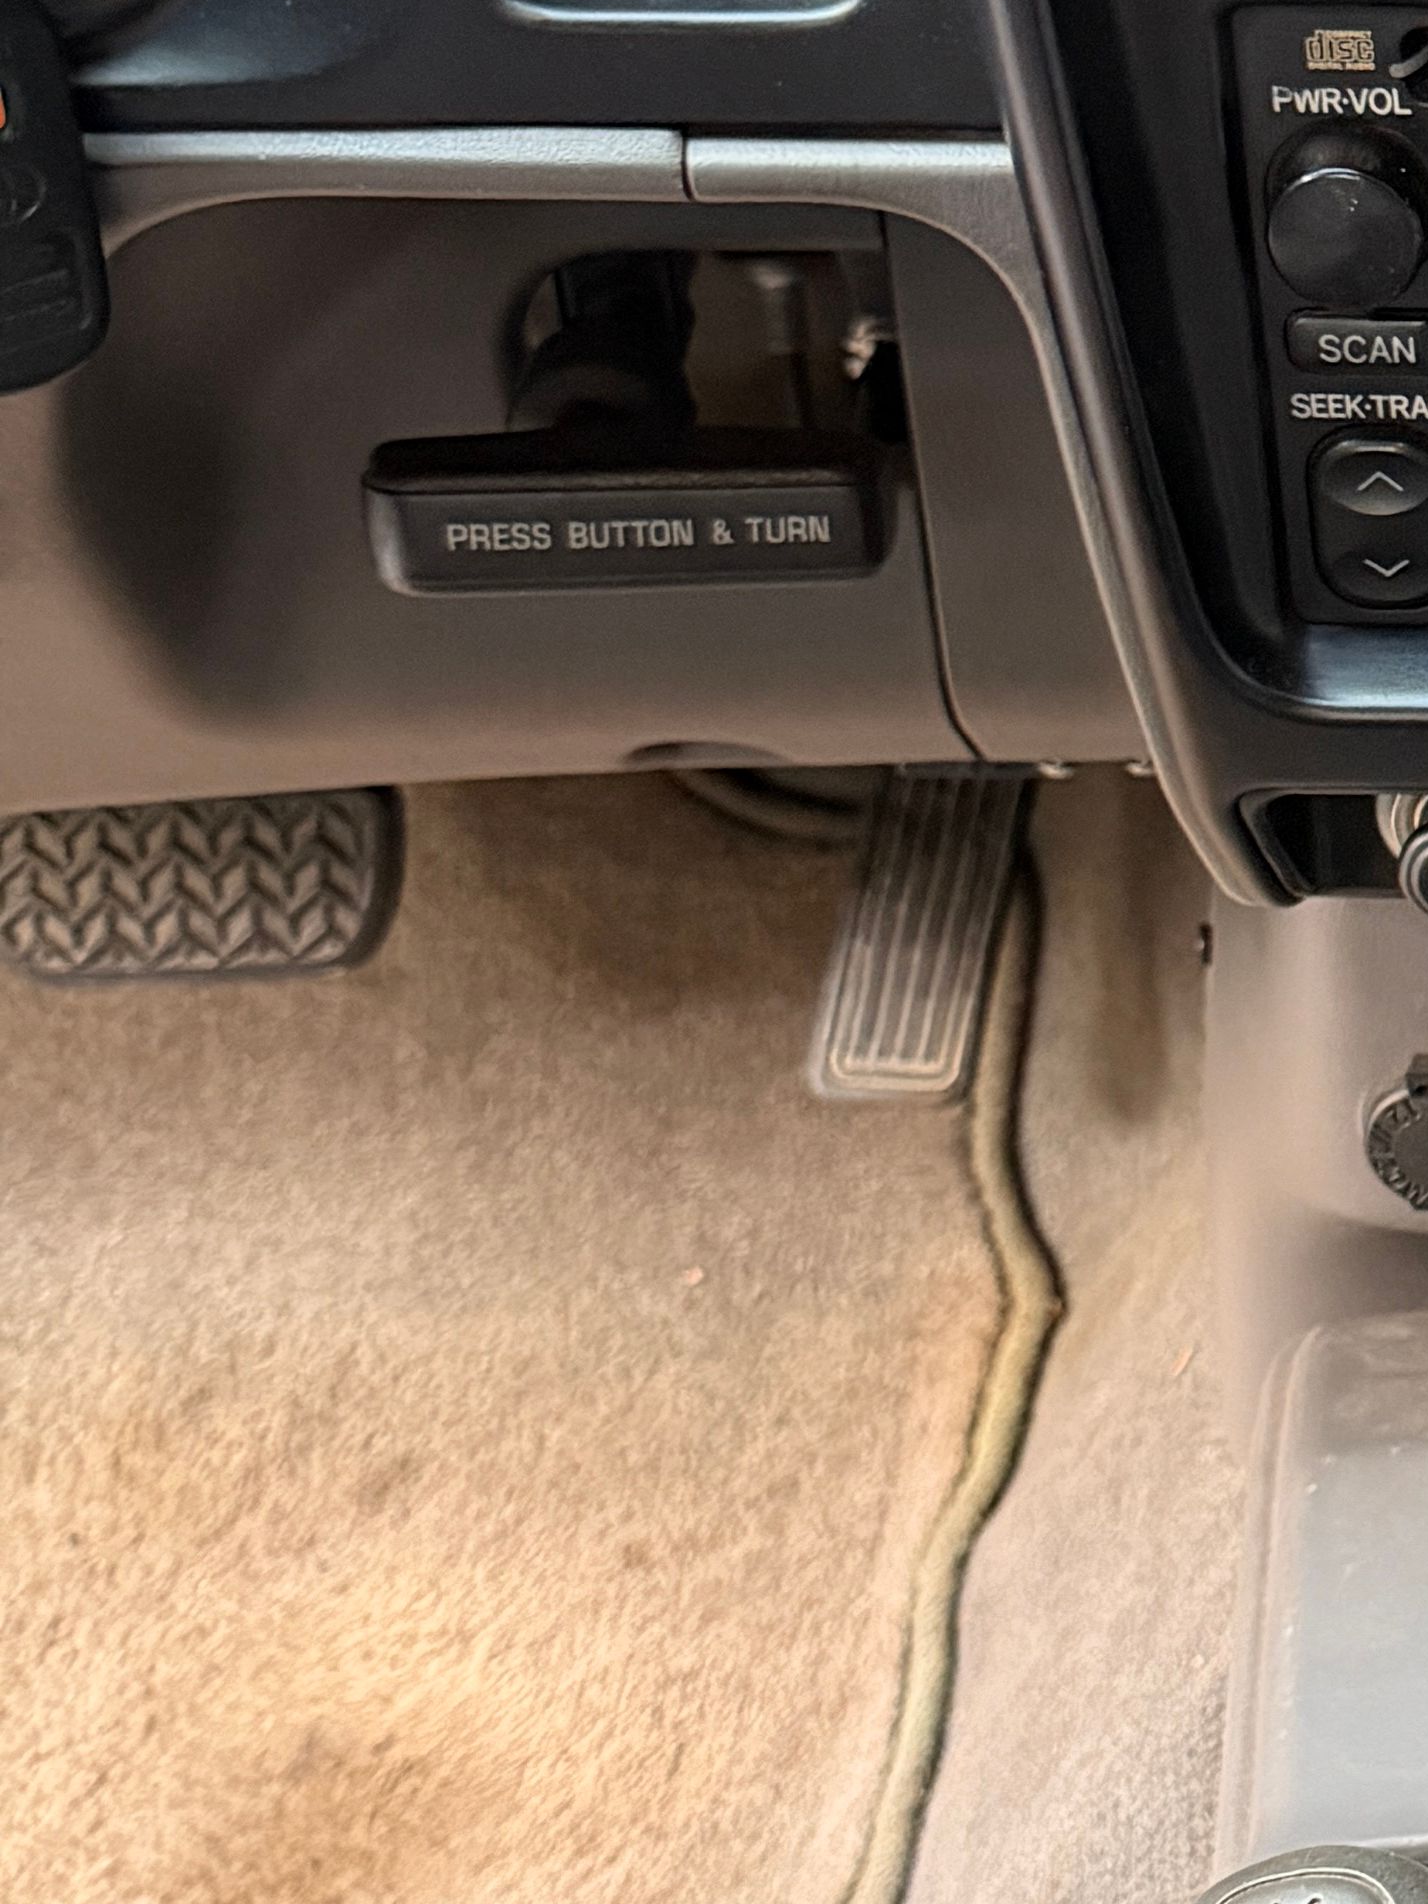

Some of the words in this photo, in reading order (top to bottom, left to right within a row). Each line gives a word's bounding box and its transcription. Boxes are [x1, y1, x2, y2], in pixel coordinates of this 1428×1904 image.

[1318, 334, 1417, 364] SCAN
[445, 522, 552, 551] PRESS
[569, 519, 694, 550] BUTTON
[713, 519, 734, 544] &
[745, 516, 831, 544] TURN
